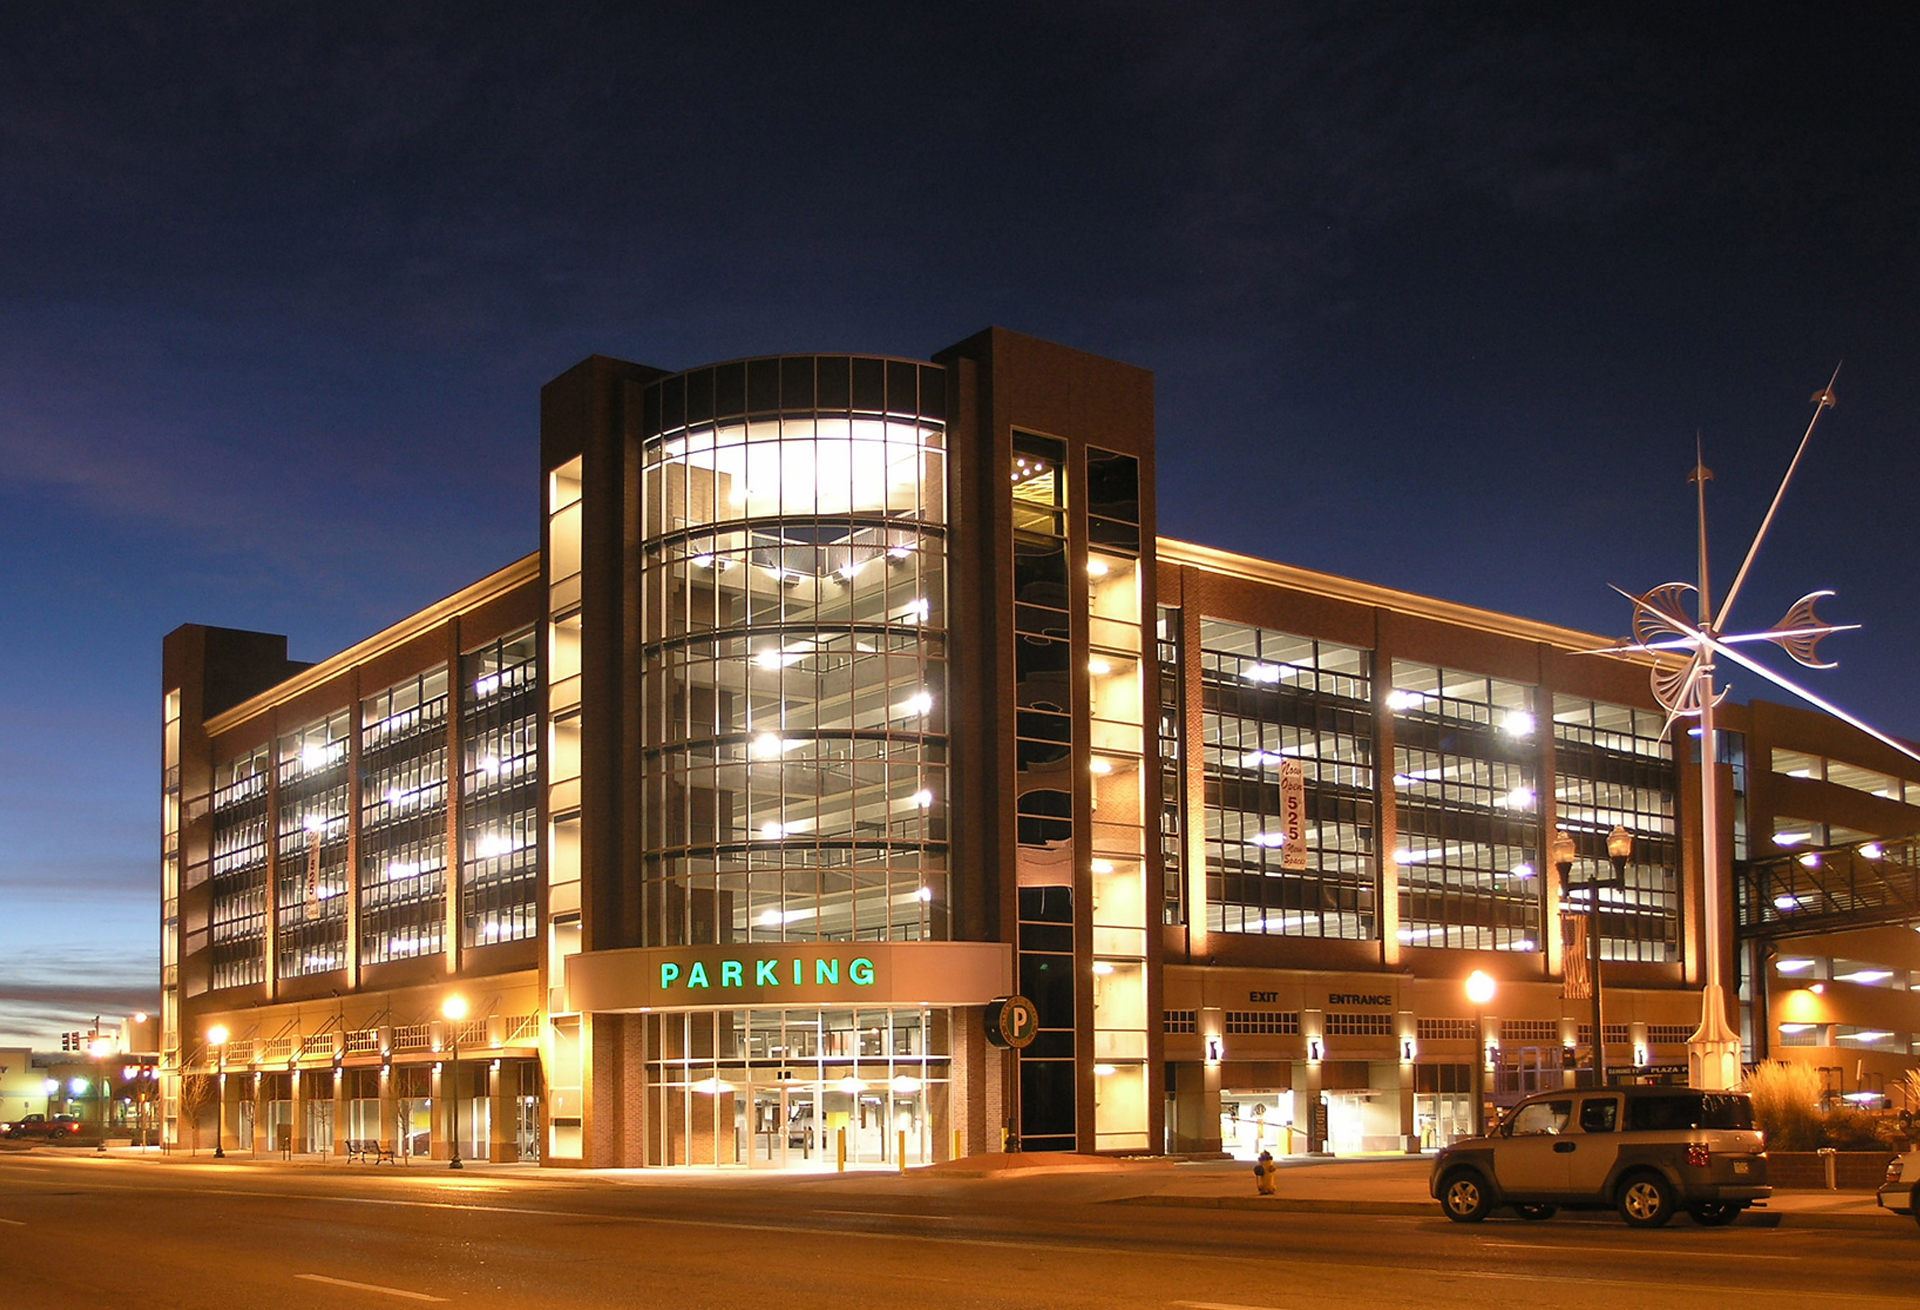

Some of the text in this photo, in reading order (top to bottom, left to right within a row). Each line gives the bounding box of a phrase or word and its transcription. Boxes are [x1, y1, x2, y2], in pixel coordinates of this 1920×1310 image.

[1281, 761, 1302, 775] Now
[1281, 778, 1303, 793] Open
[1287, 796, 1299, 840] 525
[661, 957, 875, 989] PARKING
[1250, 991, 1278, 1002] EXIT
[1328, 994, 1392, 1006] ENTRANCE
[1013, 1007, 1028, 1037] P
